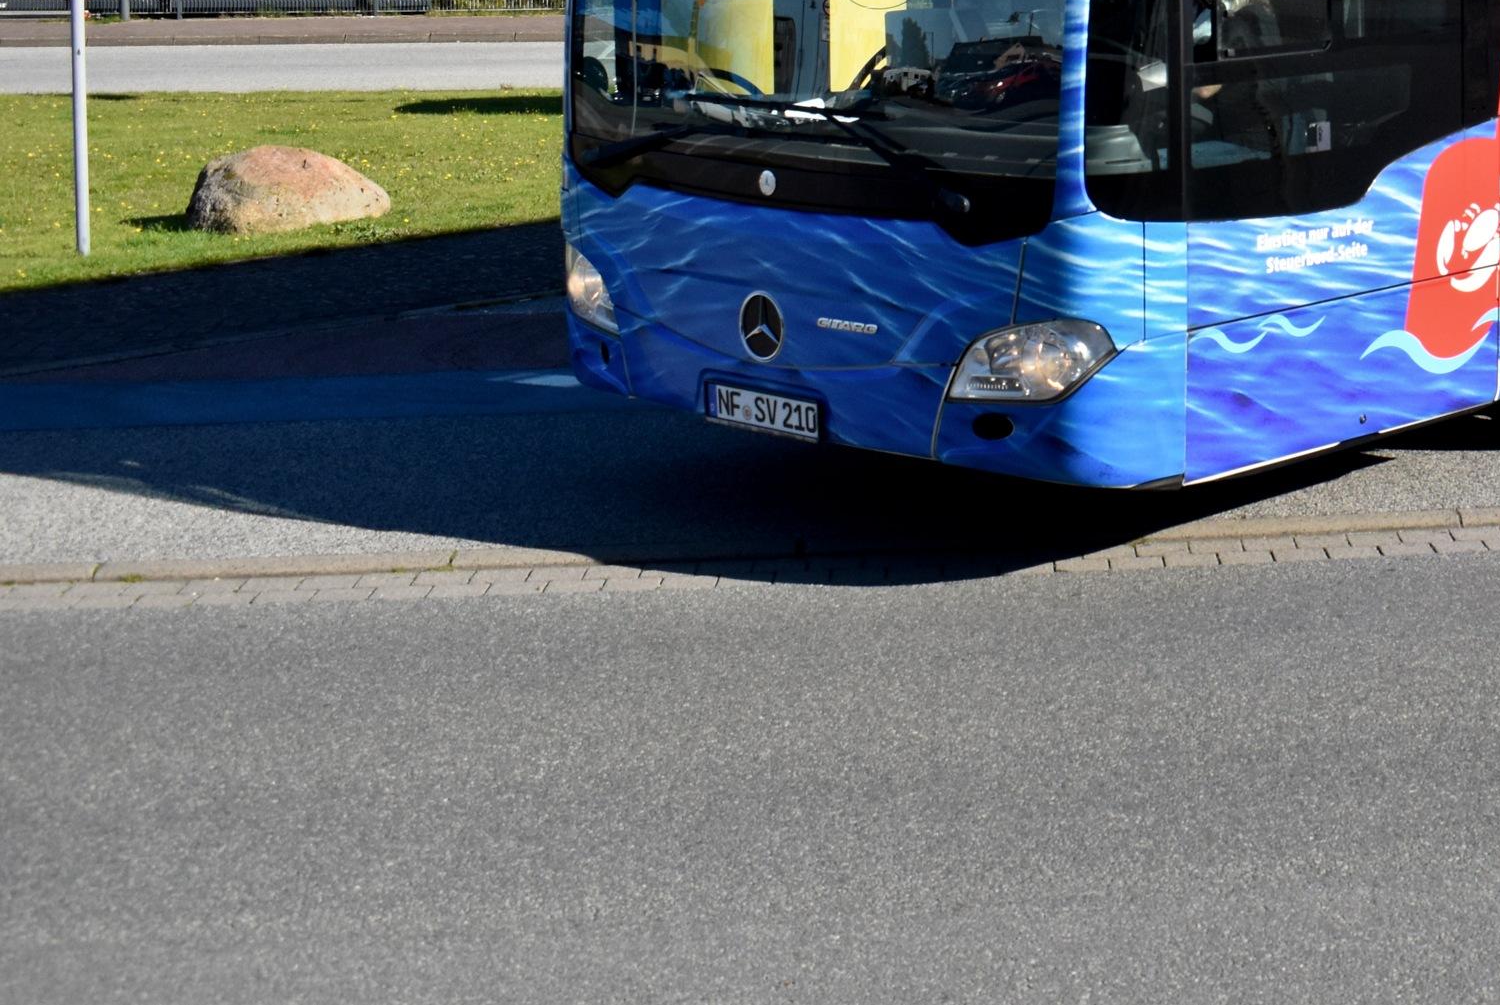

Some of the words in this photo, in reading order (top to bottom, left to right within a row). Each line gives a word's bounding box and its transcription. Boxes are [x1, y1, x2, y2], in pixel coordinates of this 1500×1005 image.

[816, 317, 878, 334] CITARO
[717, 388, 741, 416] NF
[754, 397, 778, 425] SV
[782, 402, 817, 434] 210
